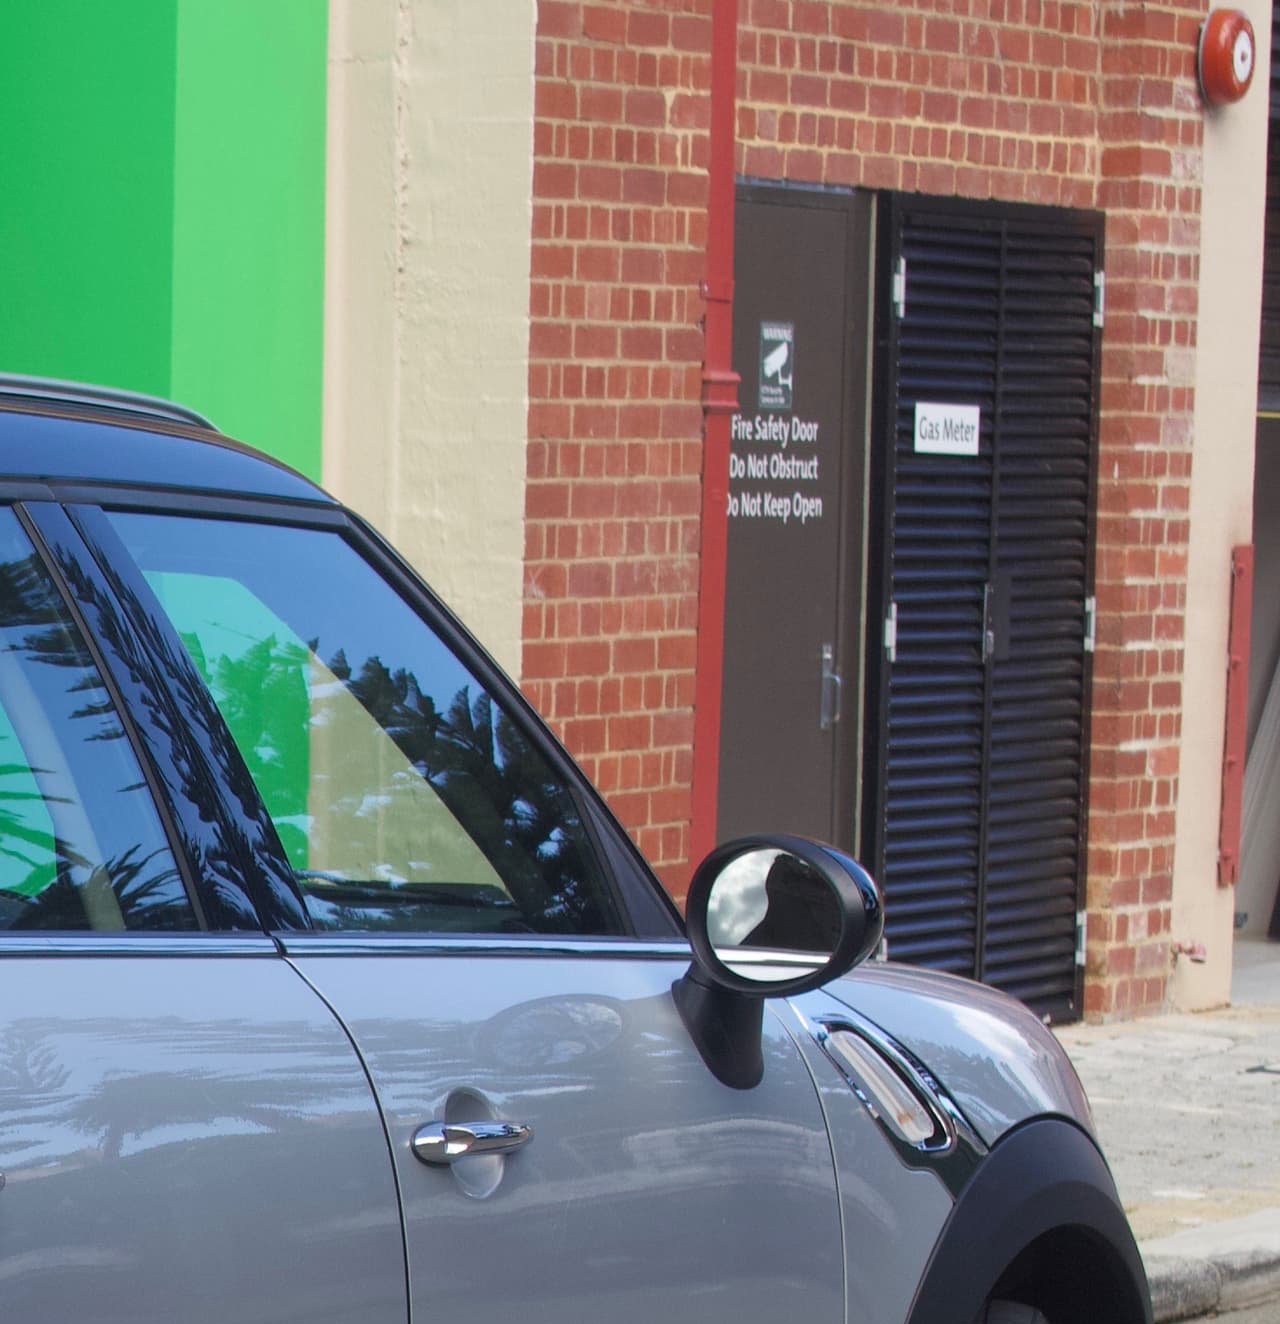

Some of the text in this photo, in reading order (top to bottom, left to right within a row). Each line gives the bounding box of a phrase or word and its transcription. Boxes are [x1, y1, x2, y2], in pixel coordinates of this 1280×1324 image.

[731, 415, 819, 448] Fire Safety Door
[919, 416, 976, 442] Gas Meter
[729, 453, 819, 481] Do Not Obstruct
[741, 492, 762, 517] Not
[764, 492, 791, 524] Keep
[792, 492, 823, 525] Open
